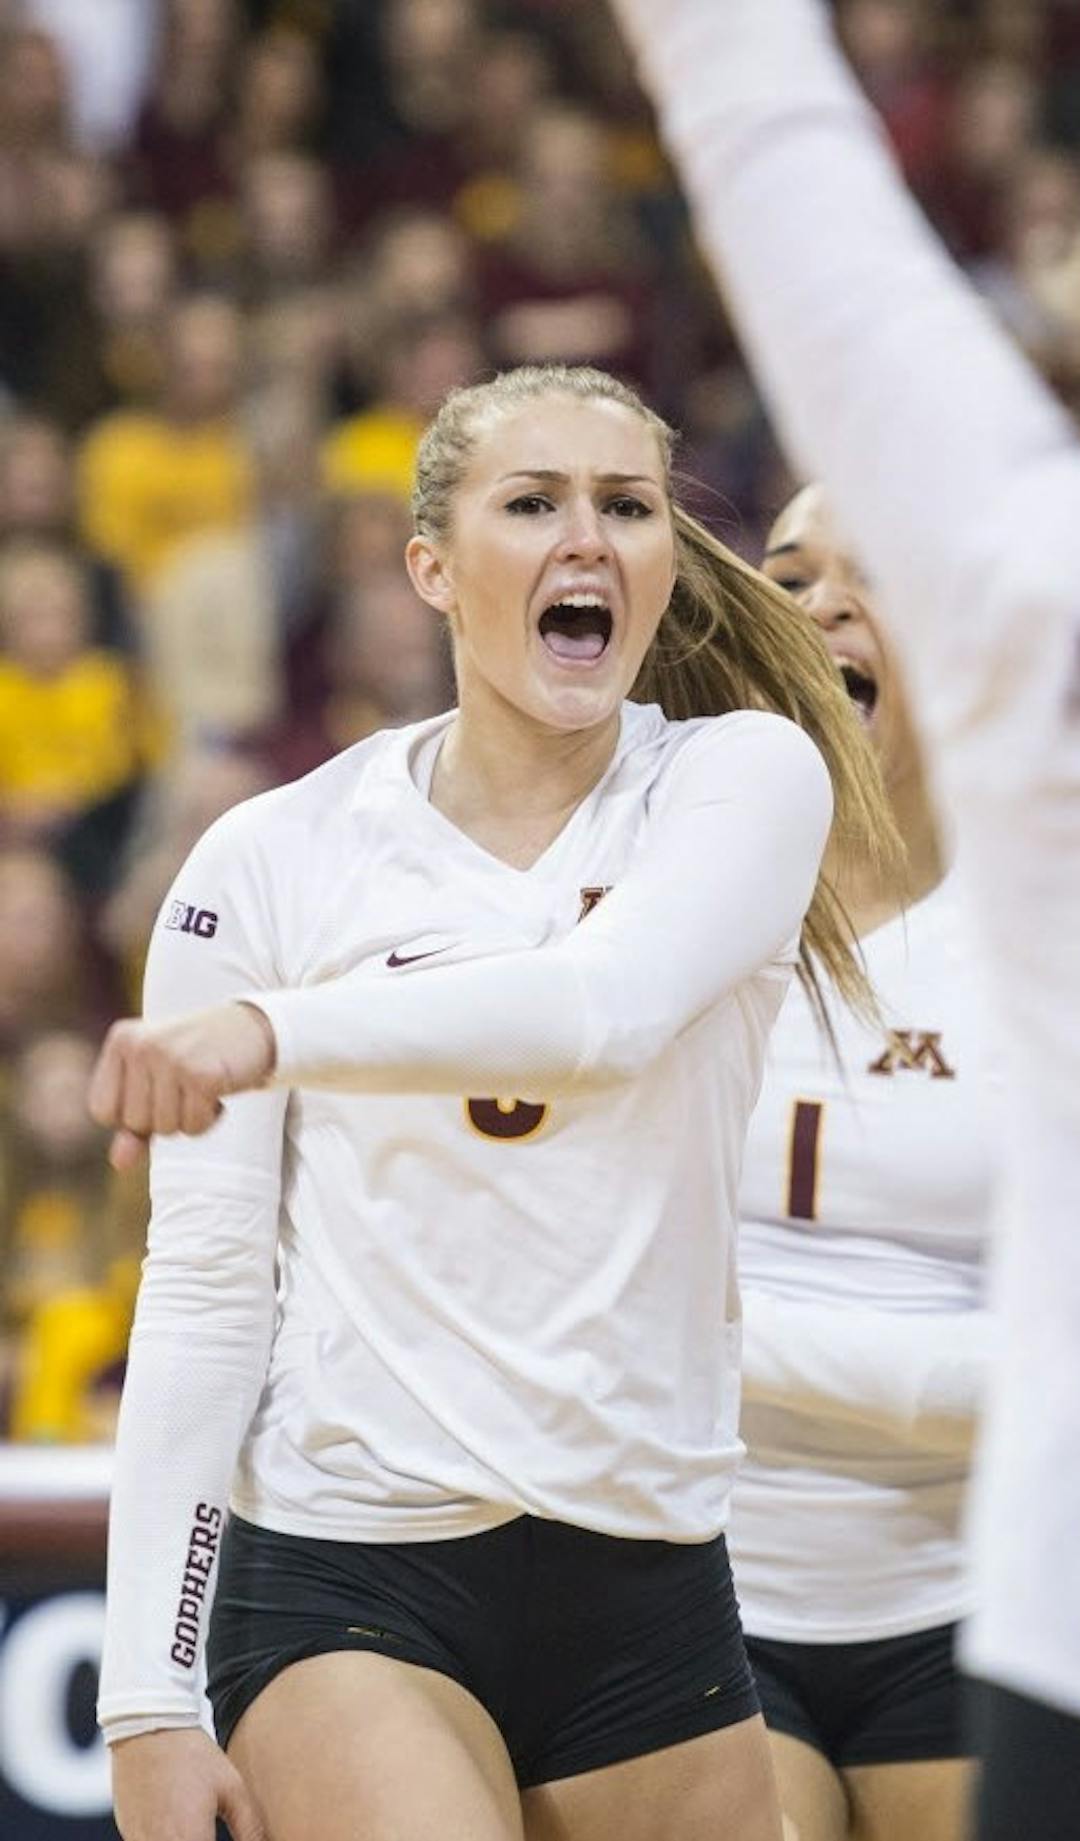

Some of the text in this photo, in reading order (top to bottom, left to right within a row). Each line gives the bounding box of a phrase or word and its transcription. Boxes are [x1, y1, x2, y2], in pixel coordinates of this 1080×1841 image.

[868, 1029, 956, 1080] M
[783, 1097, 825, 1221] 1
[170, 1502, 222, 1669] GOPHERS
